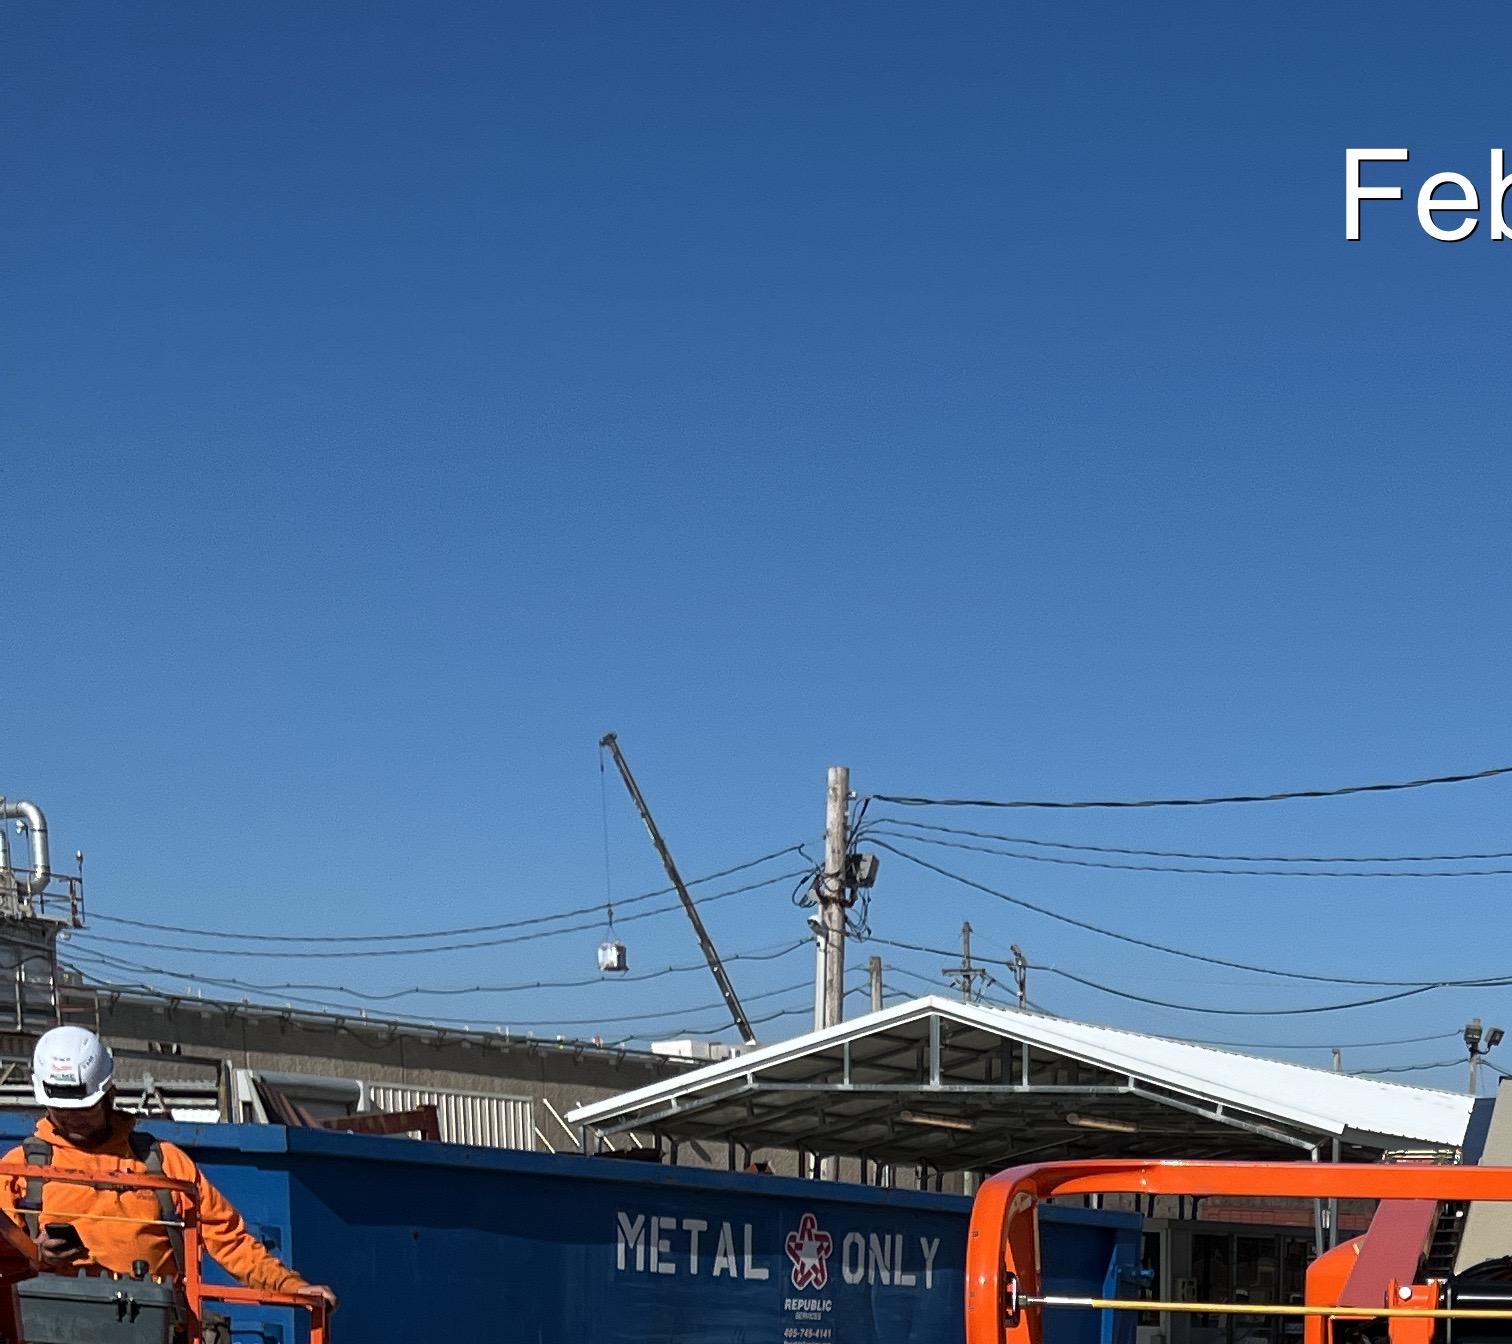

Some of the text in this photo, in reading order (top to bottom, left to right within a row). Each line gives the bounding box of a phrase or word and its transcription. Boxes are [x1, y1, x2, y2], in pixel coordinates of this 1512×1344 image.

[616, 1211, 940, 1289] METAL ONLY
[784, 1298, 832, 1312] REPUBLIC
